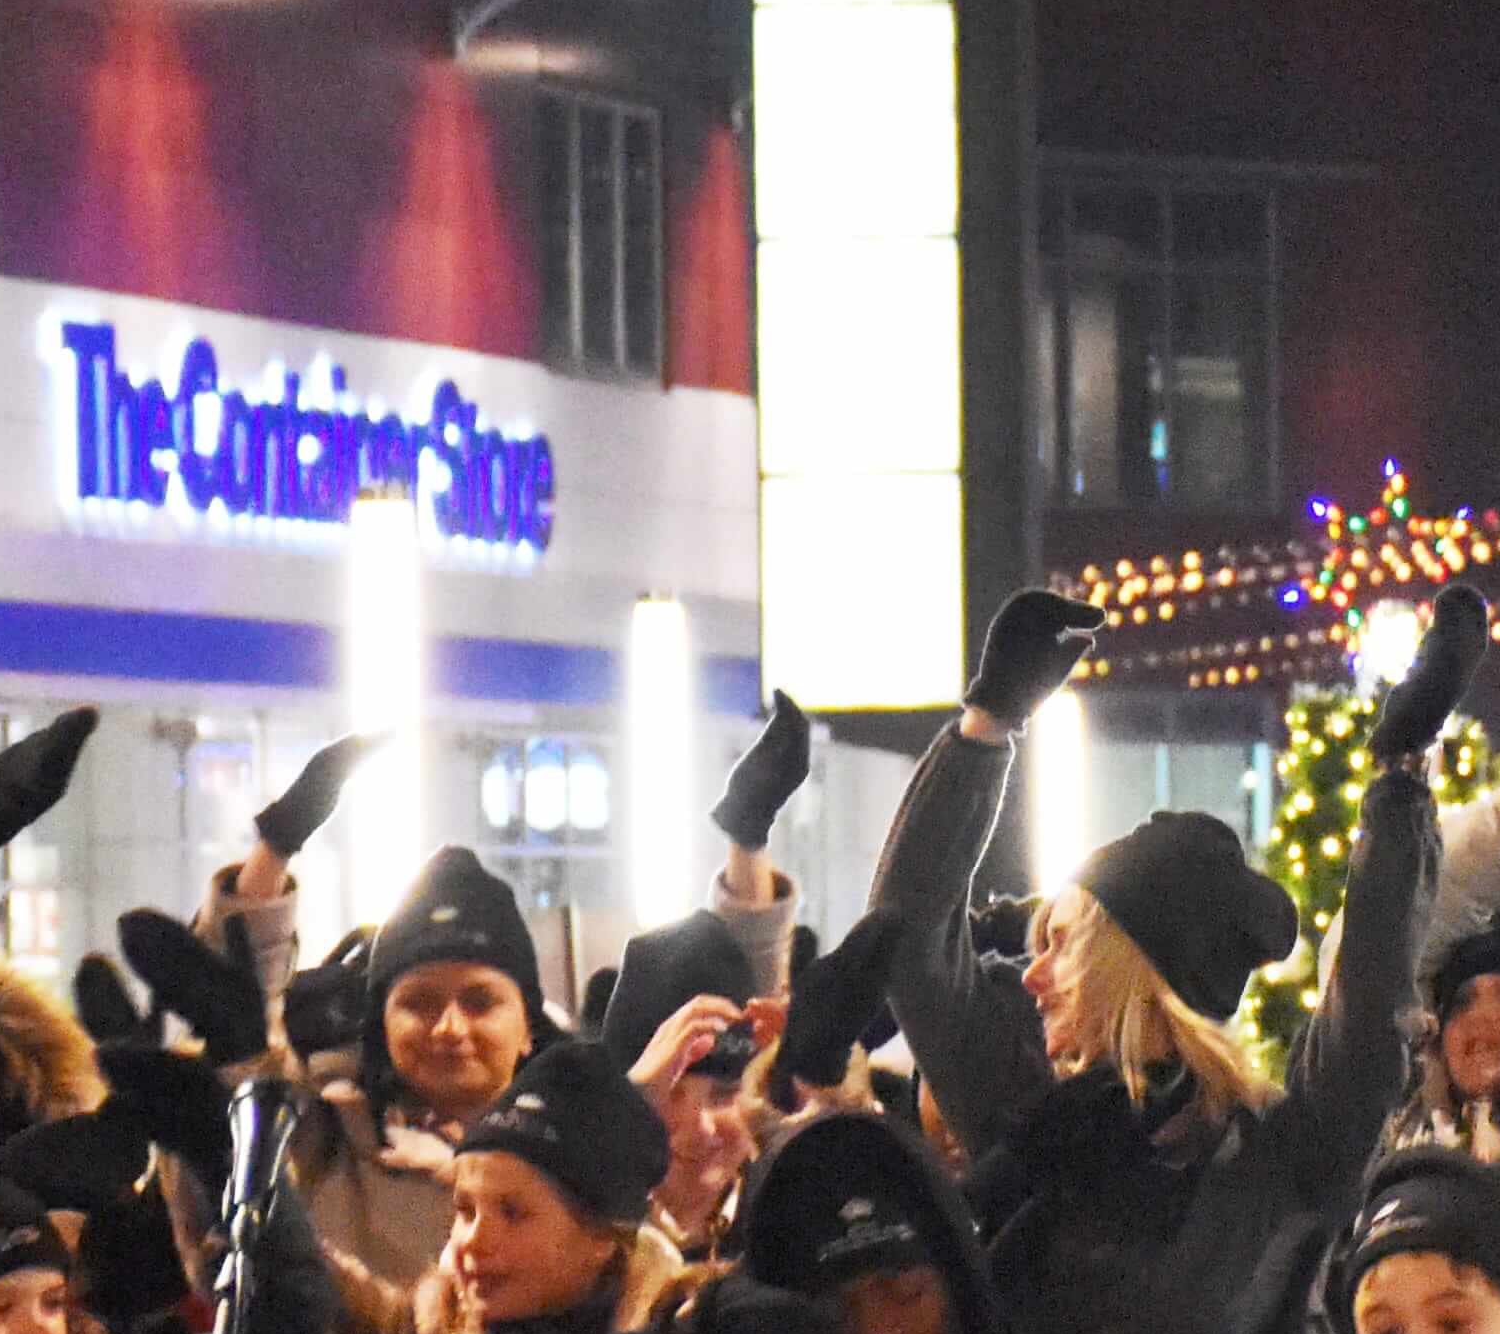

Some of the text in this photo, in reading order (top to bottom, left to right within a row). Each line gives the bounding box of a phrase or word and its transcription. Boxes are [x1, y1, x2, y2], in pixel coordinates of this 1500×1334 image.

[60, 321, 556, 553] The Container Store
